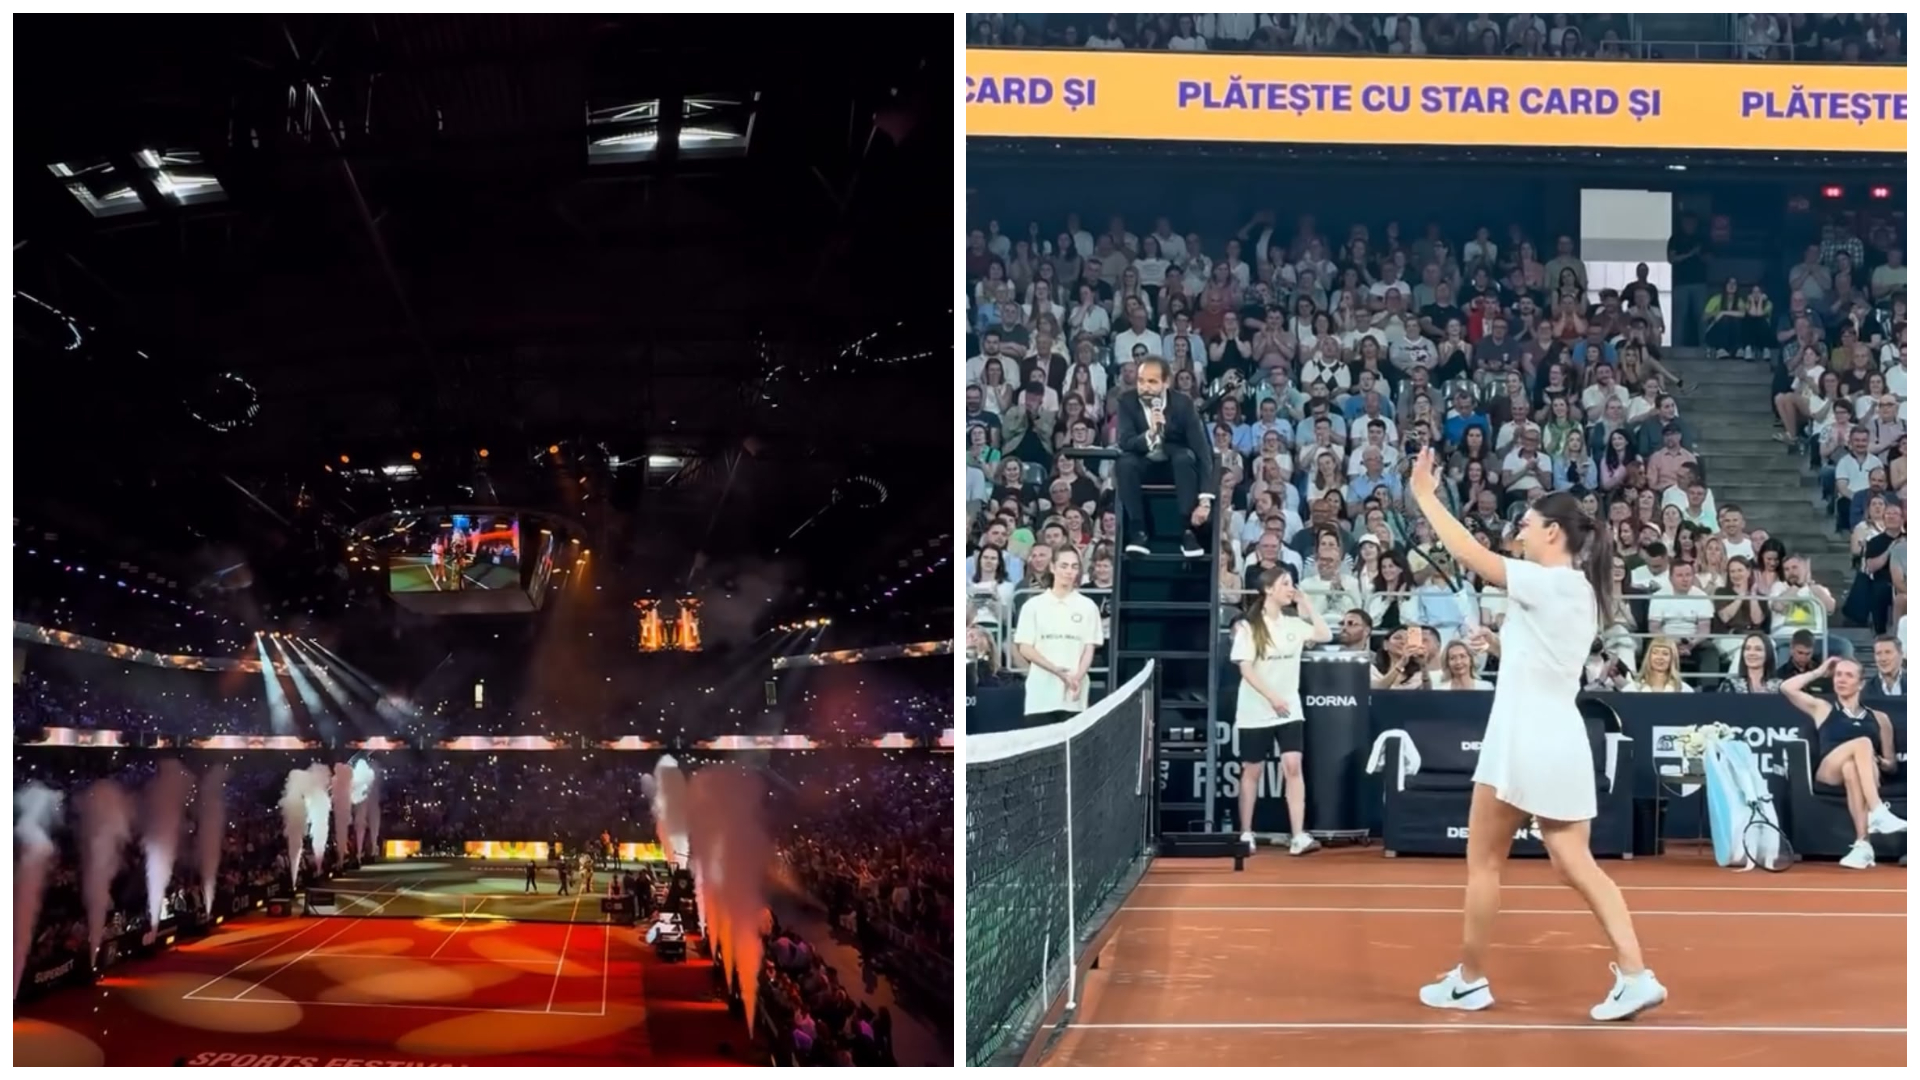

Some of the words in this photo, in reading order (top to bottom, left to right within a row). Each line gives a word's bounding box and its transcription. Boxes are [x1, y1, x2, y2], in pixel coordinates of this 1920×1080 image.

[1063, 78, 1096, 112] ȘI
[1178, 75, 1353, 116] PLĂTEȘTE
[1361, 84, 1411, 113] CU
[1420, 86, 1510, 114] STAR
[1519, 87, 1620, 115] CARD
[1628, 89, 1661, 122] ȘI
[1741, 84, 1907, 126] PLĂTEȘTE
[1305, 694, 1358, 707] DORNA
[187, 1051, 320, 1067] SPORTS
